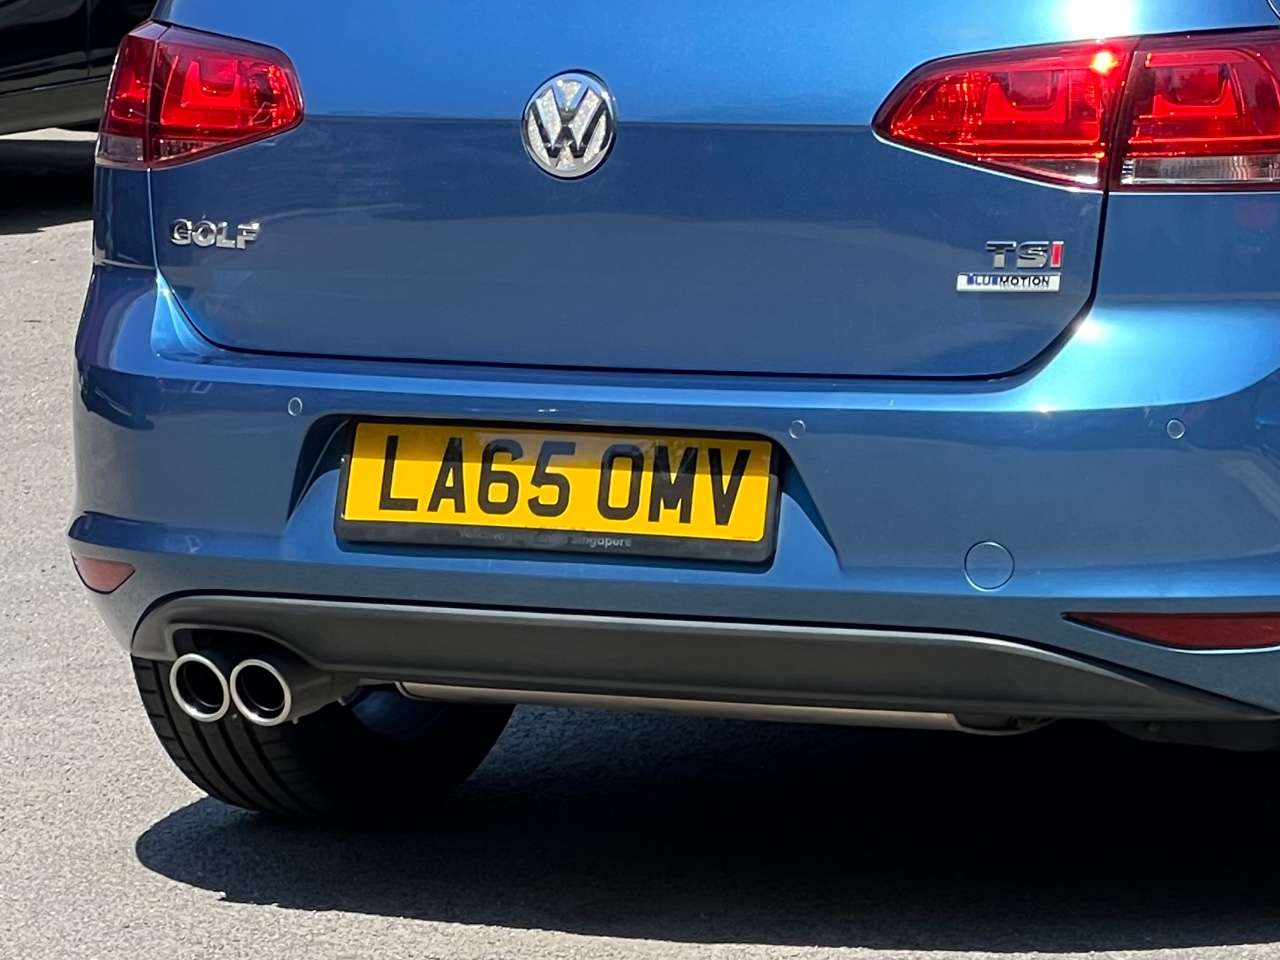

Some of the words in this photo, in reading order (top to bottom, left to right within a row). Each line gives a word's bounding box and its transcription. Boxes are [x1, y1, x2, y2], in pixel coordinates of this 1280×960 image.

[525, 73, 613, 175] VW
[170, 218, 260, 250] GOLF
[985, 240, 1064, 269] TSI
[378, 434, 577, 519] LA65
[597, 443, 752, 526] OMV
